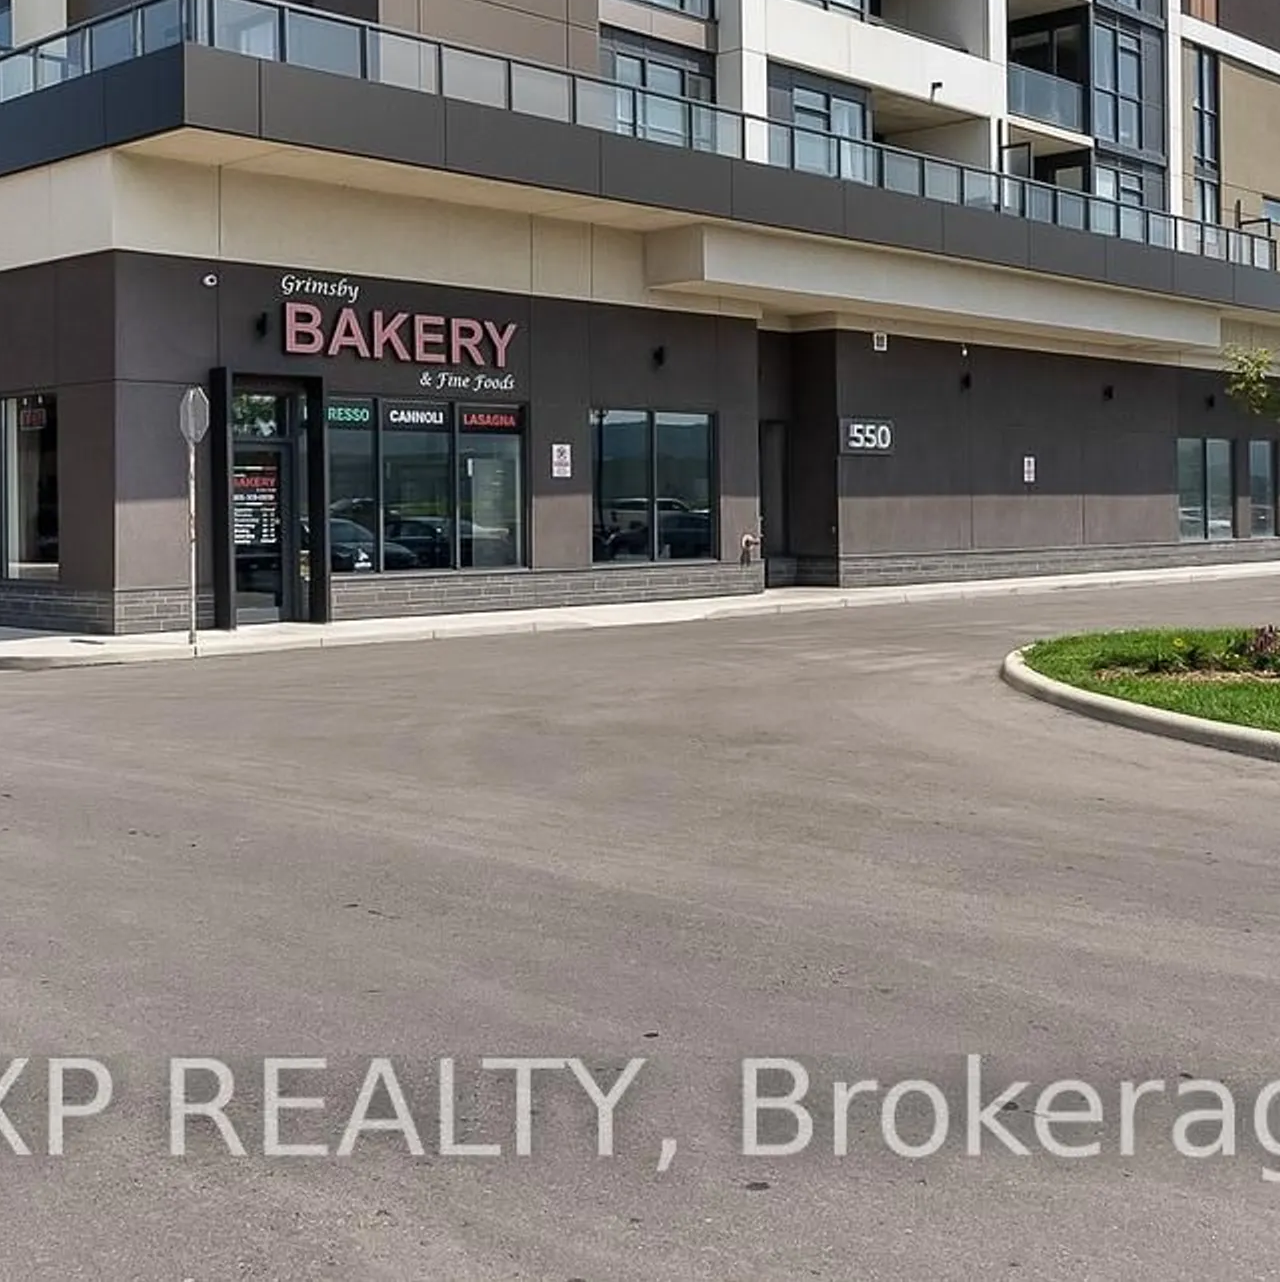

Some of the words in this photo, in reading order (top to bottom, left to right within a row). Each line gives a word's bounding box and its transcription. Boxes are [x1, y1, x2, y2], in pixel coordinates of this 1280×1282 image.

[281, 274, 360, 303] Grimsby
[284, 301, 517, 368] BAKERY
[419, 372, 432, 387] &
[436, 372, 471, 389] Fine
[473, 373, 516, 392] Foods
[389, 409, 444, 425] CANNOLI
[463, 413, 516, 427] LASAGNA
[848, 424, 891, 449] 550
